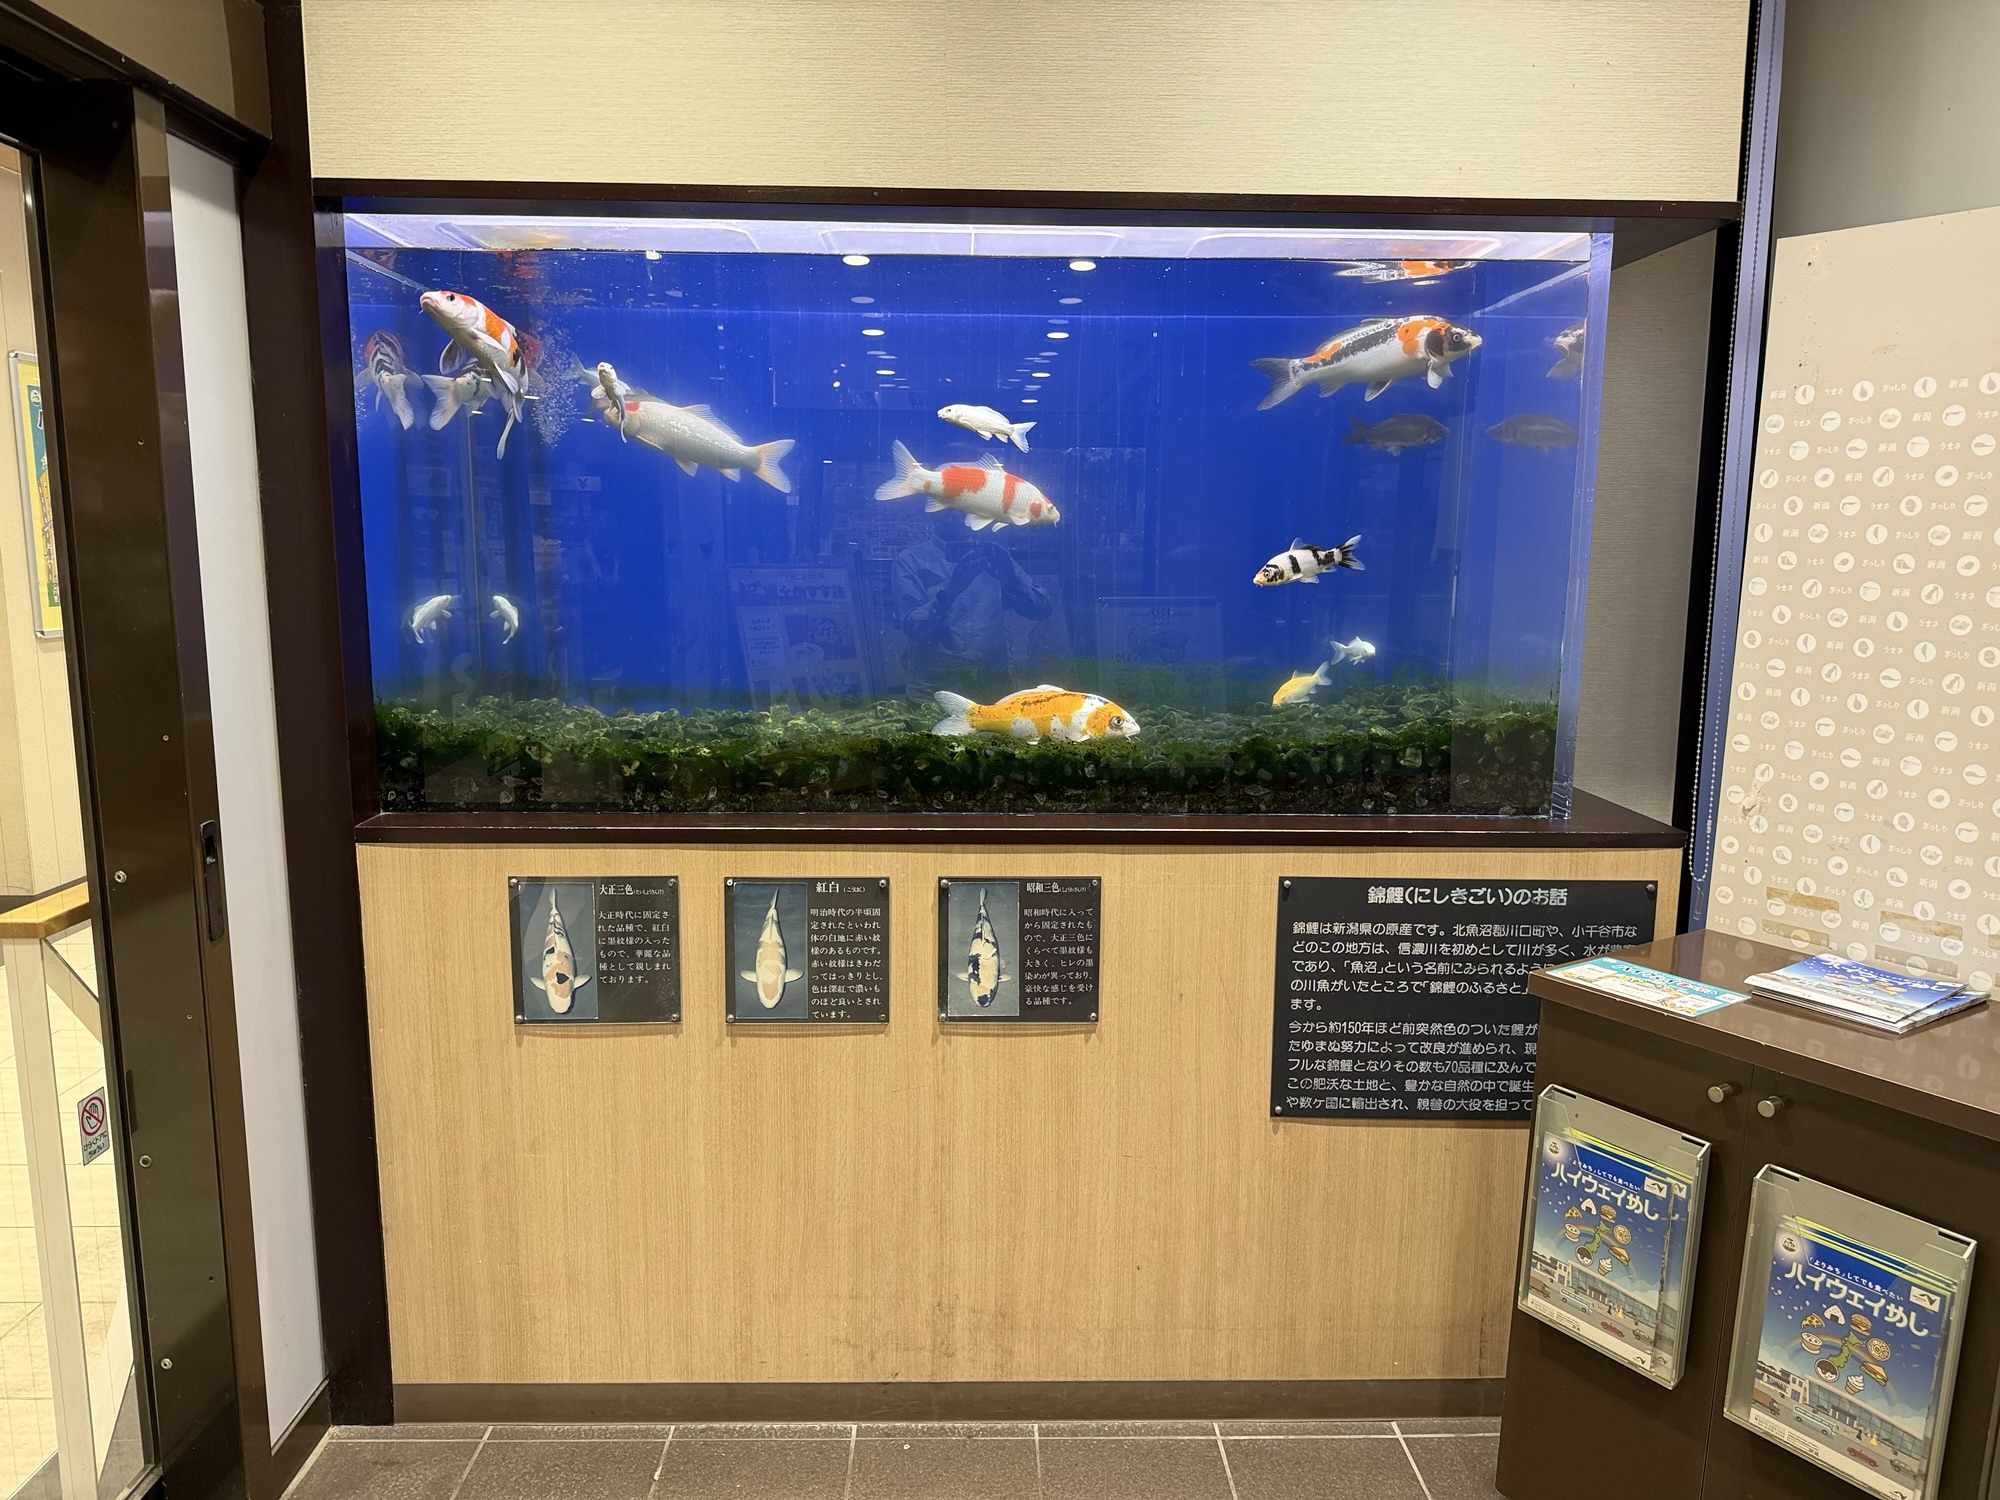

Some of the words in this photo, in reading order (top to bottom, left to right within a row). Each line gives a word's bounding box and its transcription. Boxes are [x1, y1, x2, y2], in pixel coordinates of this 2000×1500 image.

[1882, 384, 1906, 392] ぎっしり
[1949, 379, 1968, 388] 新潟
[1770, 390, 1786, 399] 新潟
[1849, 416, 1871, 424] ぎっしり
[1912, 412, 1931, 421] 新潟
[1878, 443, 1896, 452] 新潟
[1845, 473, 1862, 481] 新潟
[1967, 472, 1993, 480] ぎっしり
[1813, 502, 1830, 510] 新潟
[1931, 502, 1955, 510] ぎっしり
[1782, 529, 1798, 537] 新潟
[1896, 531, 1919, 539] ぎっしり
[1962, 531, 1982, 540] 新潟
[1927, 560, 1946, 569] 新潟
[1892, 588, 1910, 597] 新潟
[1859, 615, 1877, 624] 新潟
[1768, 637, 1789, 645] ぎっしり
[1826, 641, 1843, 650] 新潟
[1944, 651, 1969, 659] ぎっしり
[1796, 666, 1811, 674] 新潟
[1909, 677, 1933, 685] ぎっしり
[1976, 682, 1997, 692] 新潟
[1766, 688, 1781, 697] 新潟
[1876, 700, 1899, 709] ぎっしり
[1941, 706, 1960, 716] 新潟
[1737, 713, 1752, 722] 新潟
[1843, 726, 1865, 735] ぎっしり
[1905, 733, 1924, 742] 新潟
[1812, 750, 1833, 758] ぎっしり
[1872, 757, 1890, 767] 新潟
[1781, 773, 1802, 781] ぎっしり
[1839, 781, 1856, 790] 新潟
[1808, 803, 1824, 812] 新潟
[1958, 799, 1984, 809] ぎっしり
[1723, 814, 1743, 824] ぎっしり
[1777, 825, 1793, 834] 新潟
[1923, 822, 1947, 832] ぎっしり
[1748, 845, 1763, 855] 新潟
[1889, 845, 1912, 855] ぎっしり
[1954, 856, 1973, 866] 新潟
[1720, 864, 1735, 873] 新潟
[1856, 867, 1879, 877] ぎっしり
[815, 881, 840, 893] 紅白
[1919, 878, 1937, 889] 新潟
[1824, 886, 1846, 896] ぎっしり
[1367, 886, 1568, 906] 錦鯉(にしきごい)のお話
[1885, 898, 1903, 909] 新潟
[598, 910, 670, 920] 大正時代に固定さ
[810, 908, 881, 917] 明治時代の半頃固
[1024, 908, 1094, 917] 昭和時代に入って
[1793, 908, 1814, 917] ぎっしり
[597, 923, 670, 932] れた品種で、紅白
[810, 921, 881, 930] 定されたといわれ
[1024, 920, 1093, 930] から固定されたも
[1852, 920, 1869, 931] 新潟
[598, 936, 670, 945] に墨紋様の入った
[1024, 933, 1094, 942] ので、大正三色に
[810, 946, 881, 955] 様のあるものです。
[1026, 946, 1093, 955] くらべて墨紋様も
[1972, 948, 1997, 959] ぎっしり
[599, 962, 672, 971] 種として親しまれ
[810, 959, 882, 968] 赤い紋様はきわだ
[1024, 958, 1094, 968] 大きく、ヒレの墨
[600, 975, 649, 984] ております。
[812, 972, 883, 981] ってはっきりとし、
[1024, 971, 1093, 981] 染めが異っており、
[811, 984, 880, 994] 色は深紅で濃いも
[1024, 984, 1094, 993] 豪快な感じを受け
[810, 998, 882, 1006] のほど良いとされ
[1025, 996, 1072, 1006] る品種です。
[1290, 998, 1322, 1011] ます。
[812, 1010, 851, 1019] ています。
[1288, 1020, 1539, 1036] 今から約150年ほど前突然色のついた鯉が
[1288, 1040, 1538, 1055] たゆまぬ努力によって改良が進められ、現
[1288, 1059, 1536, 1074] フルな錦鯉となりその数も70品種に及んで
[1287, 1077, 1534, 1093] この肥沃な土地と、豊かな自然の中で誕生
